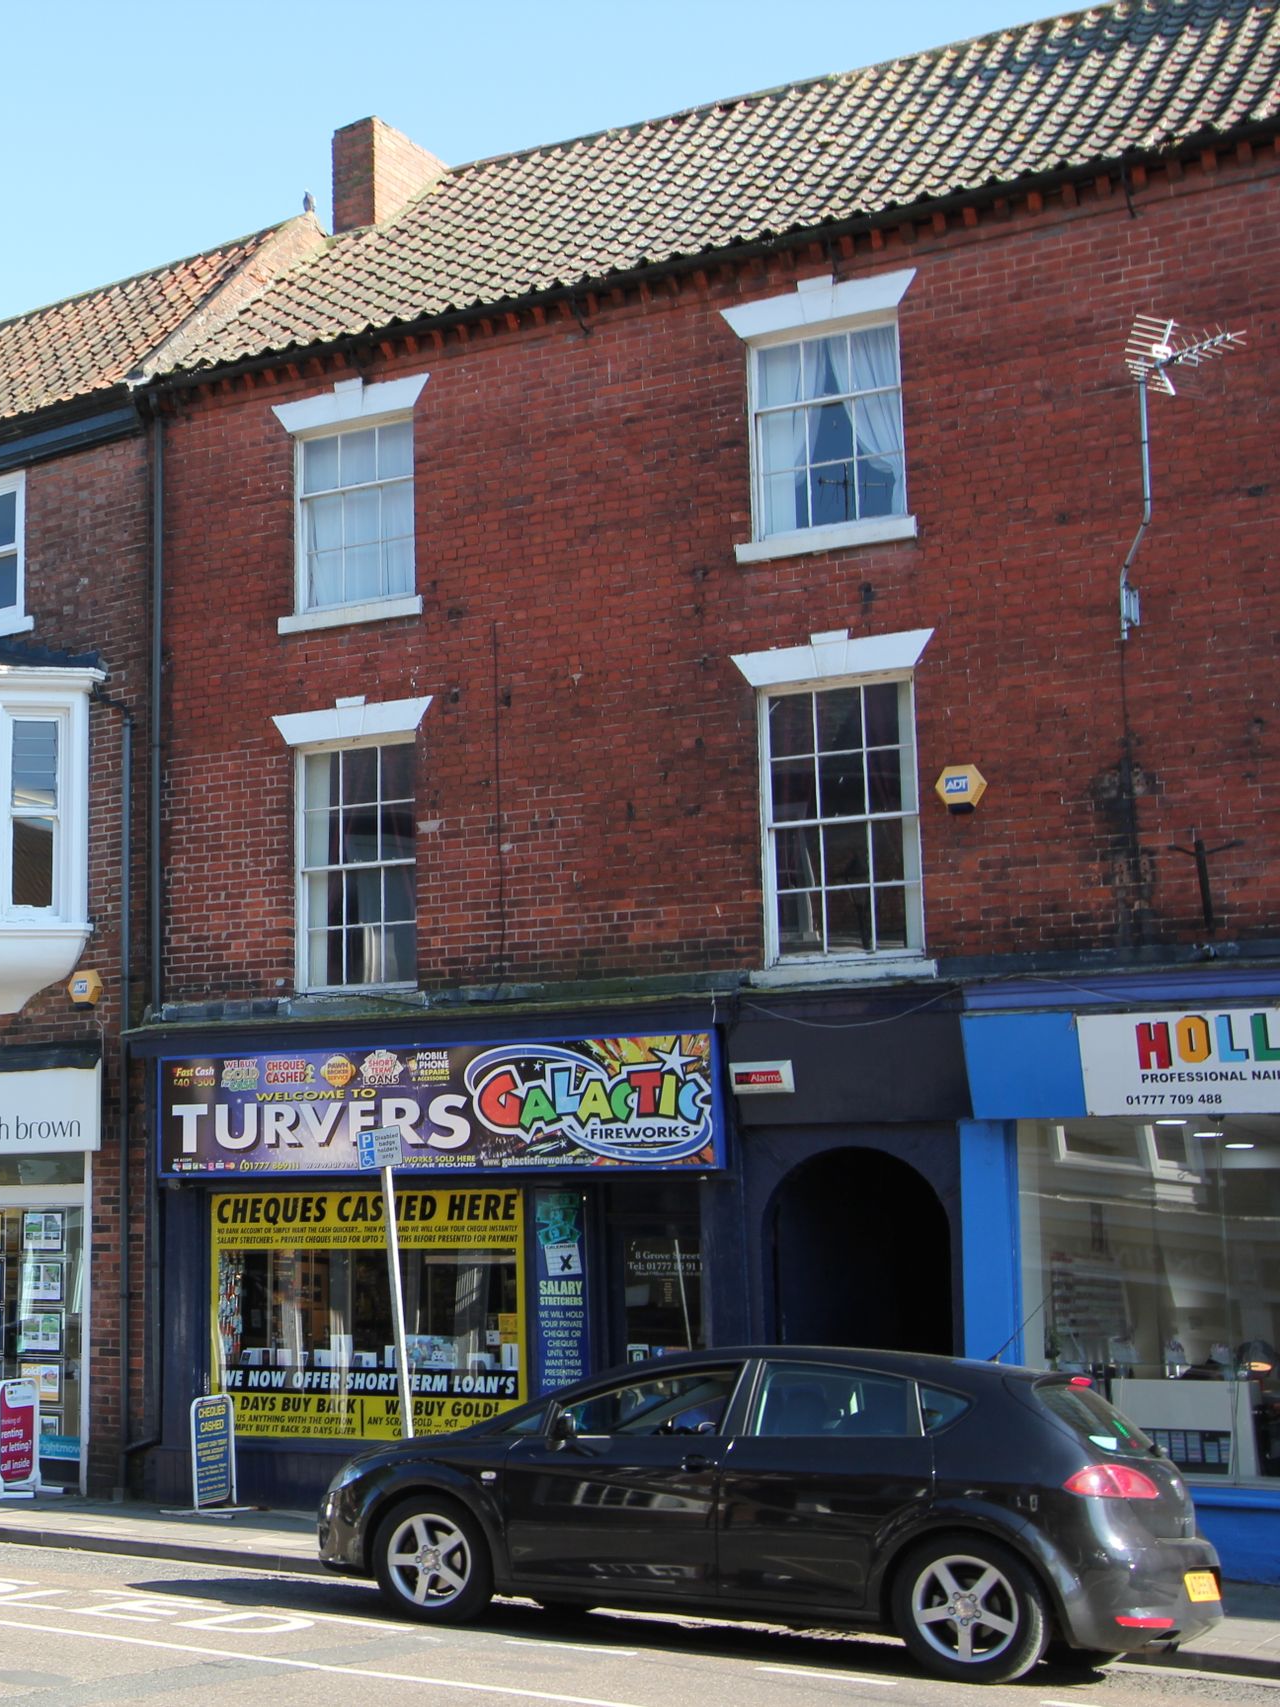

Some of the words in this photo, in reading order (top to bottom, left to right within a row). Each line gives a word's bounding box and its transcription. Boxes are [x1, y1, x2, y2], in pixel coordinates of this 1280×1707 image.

[945, 779, 968, 791] ADT
[1135, 1013, 1280, 1070] HOLL
[416, 1051, 448, 1061] MOBILE
[224, 1060, 238, 1069] WE
[239, 1059, 257, 1068] BUY
[266, 1060, 306, 1071] CHEQUES
[368, 1058, 394, 1067] SHORT
[419, 1060, 450, 1069] PHONE
[176, 1067, 194, 1077] Fast
[195, 1066, 215, 1076] Cash
[222, 1068, 260, 1081] GOLD
[419, 1068, 450, 1076] REPAIRS
[265, 1072, 306, 1085] CASHED
[363, 1074, 400, 1085] LOANS
[1141, 1071, 1247, 1084] PROFESSIONAL
[256, 1089, 345, 1102] WELCOME
[351, 1088, 377, 1099] TO
[478, 1068, 702, 1130] GALACTIC
[1125, 1095, 1165, 1106] 01777
[1169, 1094, 1194, 1105] 709
[1198, 1094, 1222, 1105] 488
[16, 1115, 81, 1140] brown
[171, 1093, 472, 1154] TURVERS
[374, 1132, 399, 1141] Disabled
[590, 1126, 691, 1140] FIREWORKS
[362, 1135, 371, 1148] P
[434, 1155, 456, 1163] SOLD
[243, 1161, 270, 1170] 01777
[217, 1196, 327, 1226] CHEQUES
[447, 1194, 518, 1221] HERE
[398, 1225, 409, 1233] AND
[488, 1224, 518, 1232] INSTANTLY
[217, 1236, 238, 1244] SALARY
[239, 1236, 274, 1244] STRETCHERS
[305, 1235, 331, 1243] CHEQUES
[332, 1235, 348, 1243] HELD
[348, 1235, 361, 1243] FOR
[361, 1235, 379, 1243] UPTO
[413, 1235, 436, 1243] BEFORE
[437, 1234, 472, 1243] PRESENTED
[486, 1234, 518, 1242] PAYMENT
[642, 1250, 671, 1260] Grove
[672, 1251, 701, 1260] Street
[627, 1261, 645, 1271] Tel:
[646, 1262, 672, 1271] 01777
[539, 1280, 583, 1296] SALARY
[539, 1296, 583, 1306] STRETCHERS
[539, 1311, 549, 1319] WE
[550, 1311, 565, 1319] WILL
[565, 1310, 584, 1319] HOLD
[541, 1320, 558, 1328] YOUR
[559, 1320, 583, 1328] PRIVATE
[543, 1330, 570, 1338] CHEQUE
[547, 1339, 578, 1347] CHEQUES
[546, 1349, 563, 1357] UNTIL
[564, 1349, 579, 1357] YOU
[545, 1359, 562, 1367] WANT
[563, 1358, 582, 1366] THEM
[544, 1368, 583, 1377] PRESENTING
[222, 1369, 243, 1387] WE
[247, 1370, 287, 1388] NOW
[292, 1371, 340, 1389] OFFER
[344, 1371, 397, 1391] SHORT
[453, 1374, 516, 1394] LOAN'S
[542, 1378, 556, 1386] FOR
[557, 1378, 580, 1386] PAYM
[240, 1396, 277, 1412] DAYS
[281, 1397, 312, 1413] BUY
[316, 1398, 357, 1414] BACK
[413, 1401, 446, 1417] BUY
[451, 1401, 500, 1418] GOLD!
[198, 1404, 226, 1419] CHEQUES
[236, 1414, 246, 1422] US
[248, 1414, 286, 1424] ANYTHING
[287, 1416, 307, 1425] WITH
[309, 1416, 321, 1425] THE
[323, 1416, 353, 1426] OPTION
[367, 1417, 384, 1425] ANY
[385, 1418, 401, 1426] SCR
[412, 1418, 433, 1427] GOLD
[444, 1419, 458, 1428] 9CT
[0, 1428, 24, 1440] renting
[234, 1423, 253, 1431] MPLY
[255, 1424, 270, 1432] BUY
[280, 1425, 299, 1433] BACK
[301, 1425, 311, 1434] 28
[313, 1426, 333, 1435] DAYS
[334, 1427, 356, 1435] LATER
[8, 1440, 32, 1453] letting?
[0, 1460, 11, 1472] call
[12, 1458, 31, 1470] inside
